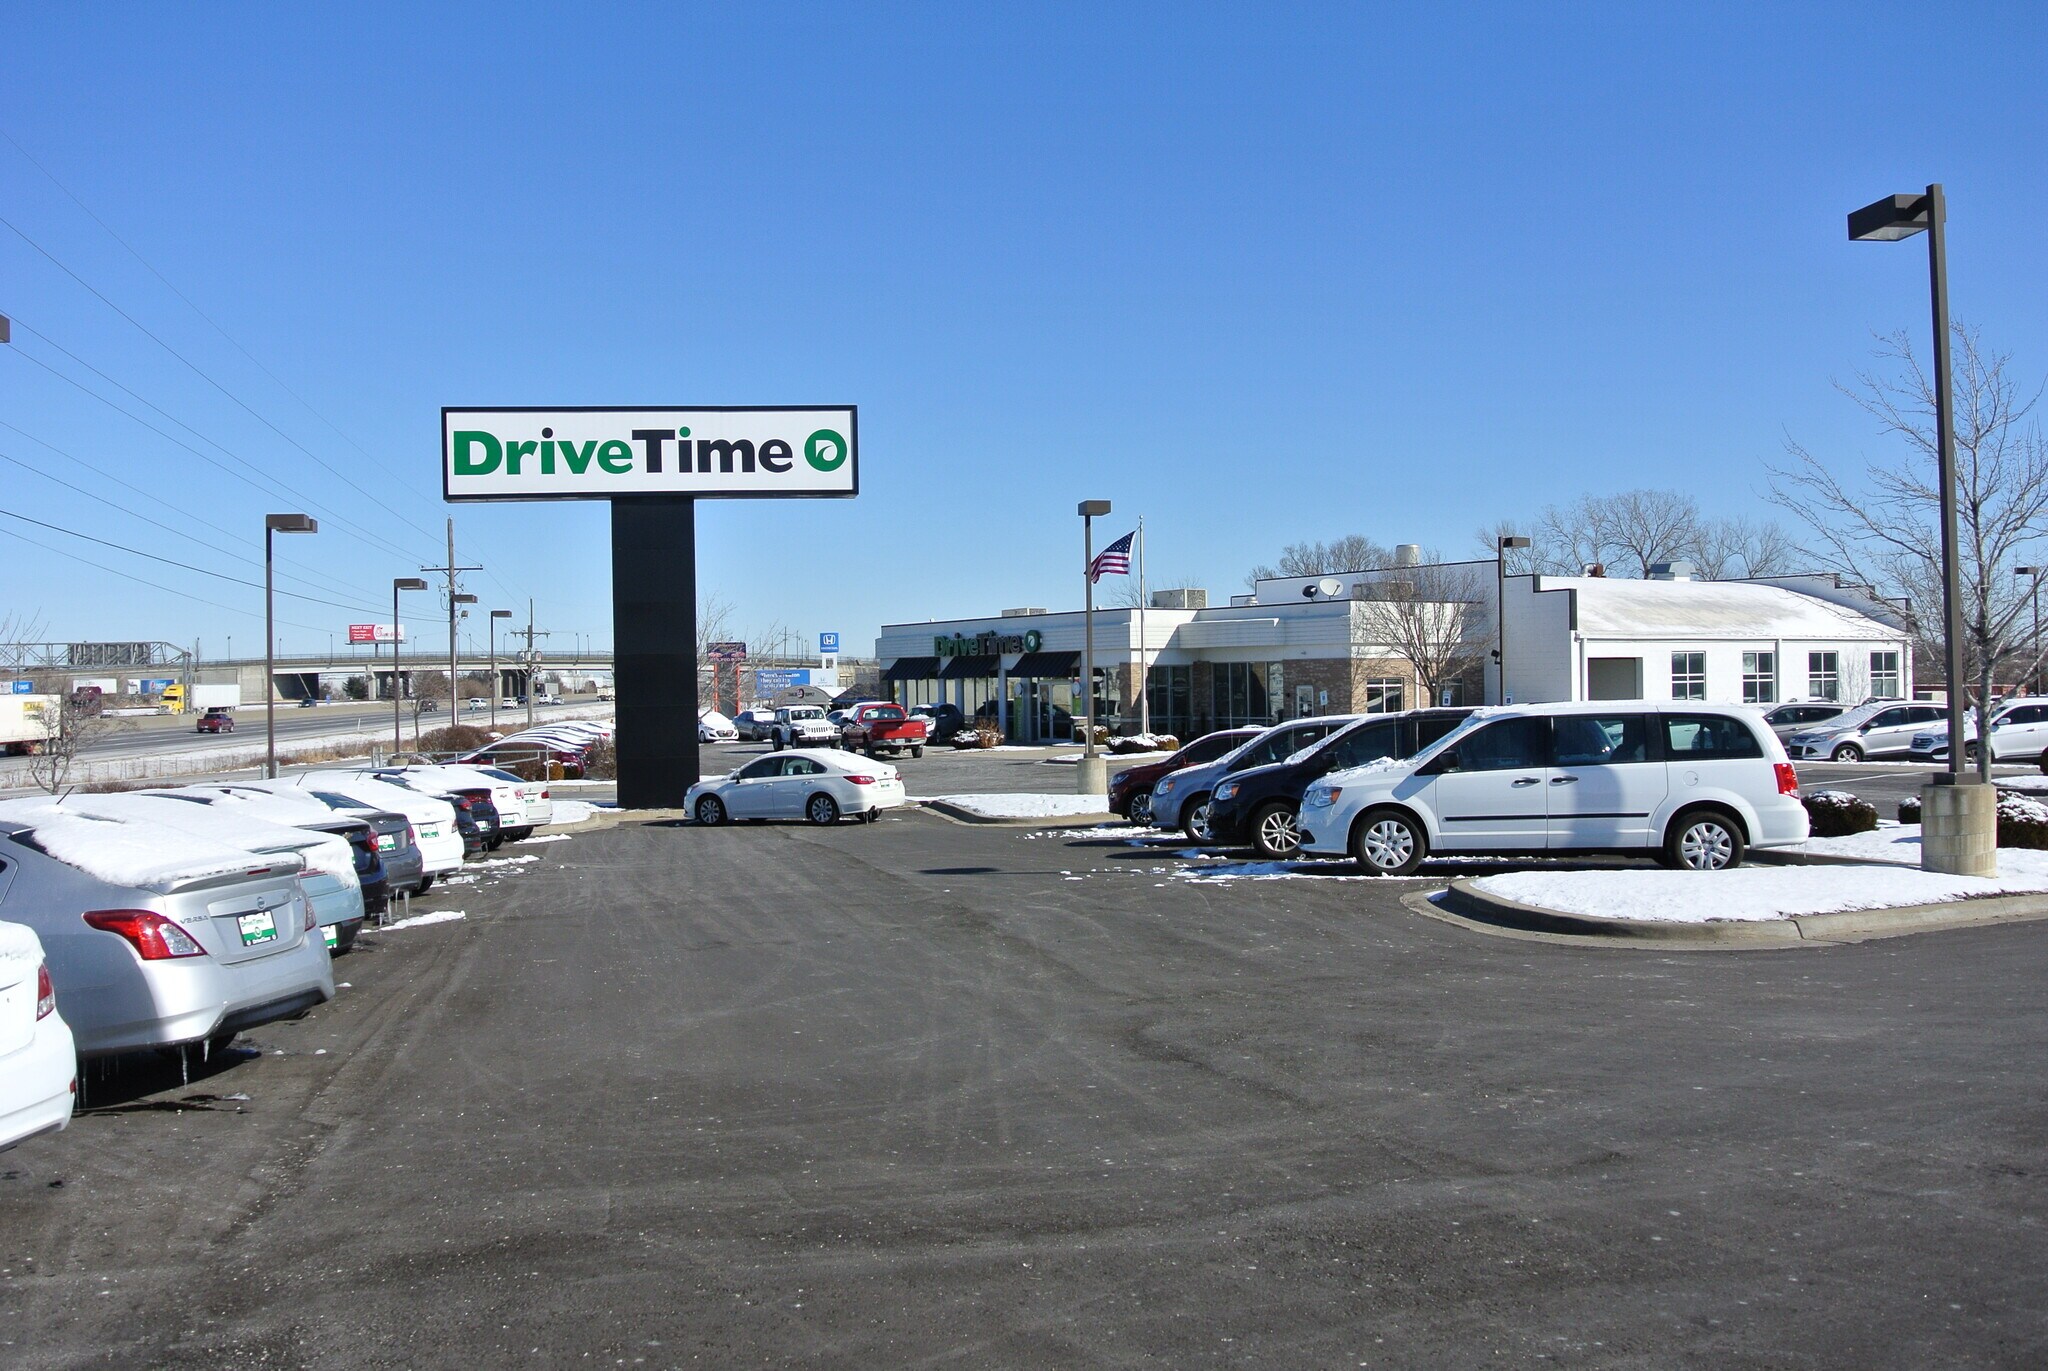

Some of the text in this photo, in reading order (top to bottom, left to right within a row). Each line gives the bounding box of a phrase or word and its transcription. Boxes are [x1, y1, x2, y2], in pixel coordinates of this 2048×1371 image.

[453, 426, 793, 475] DriveTime
[934, 630, 1021, 657] DriveTime
[179, 915, 209, 925] VERSA
